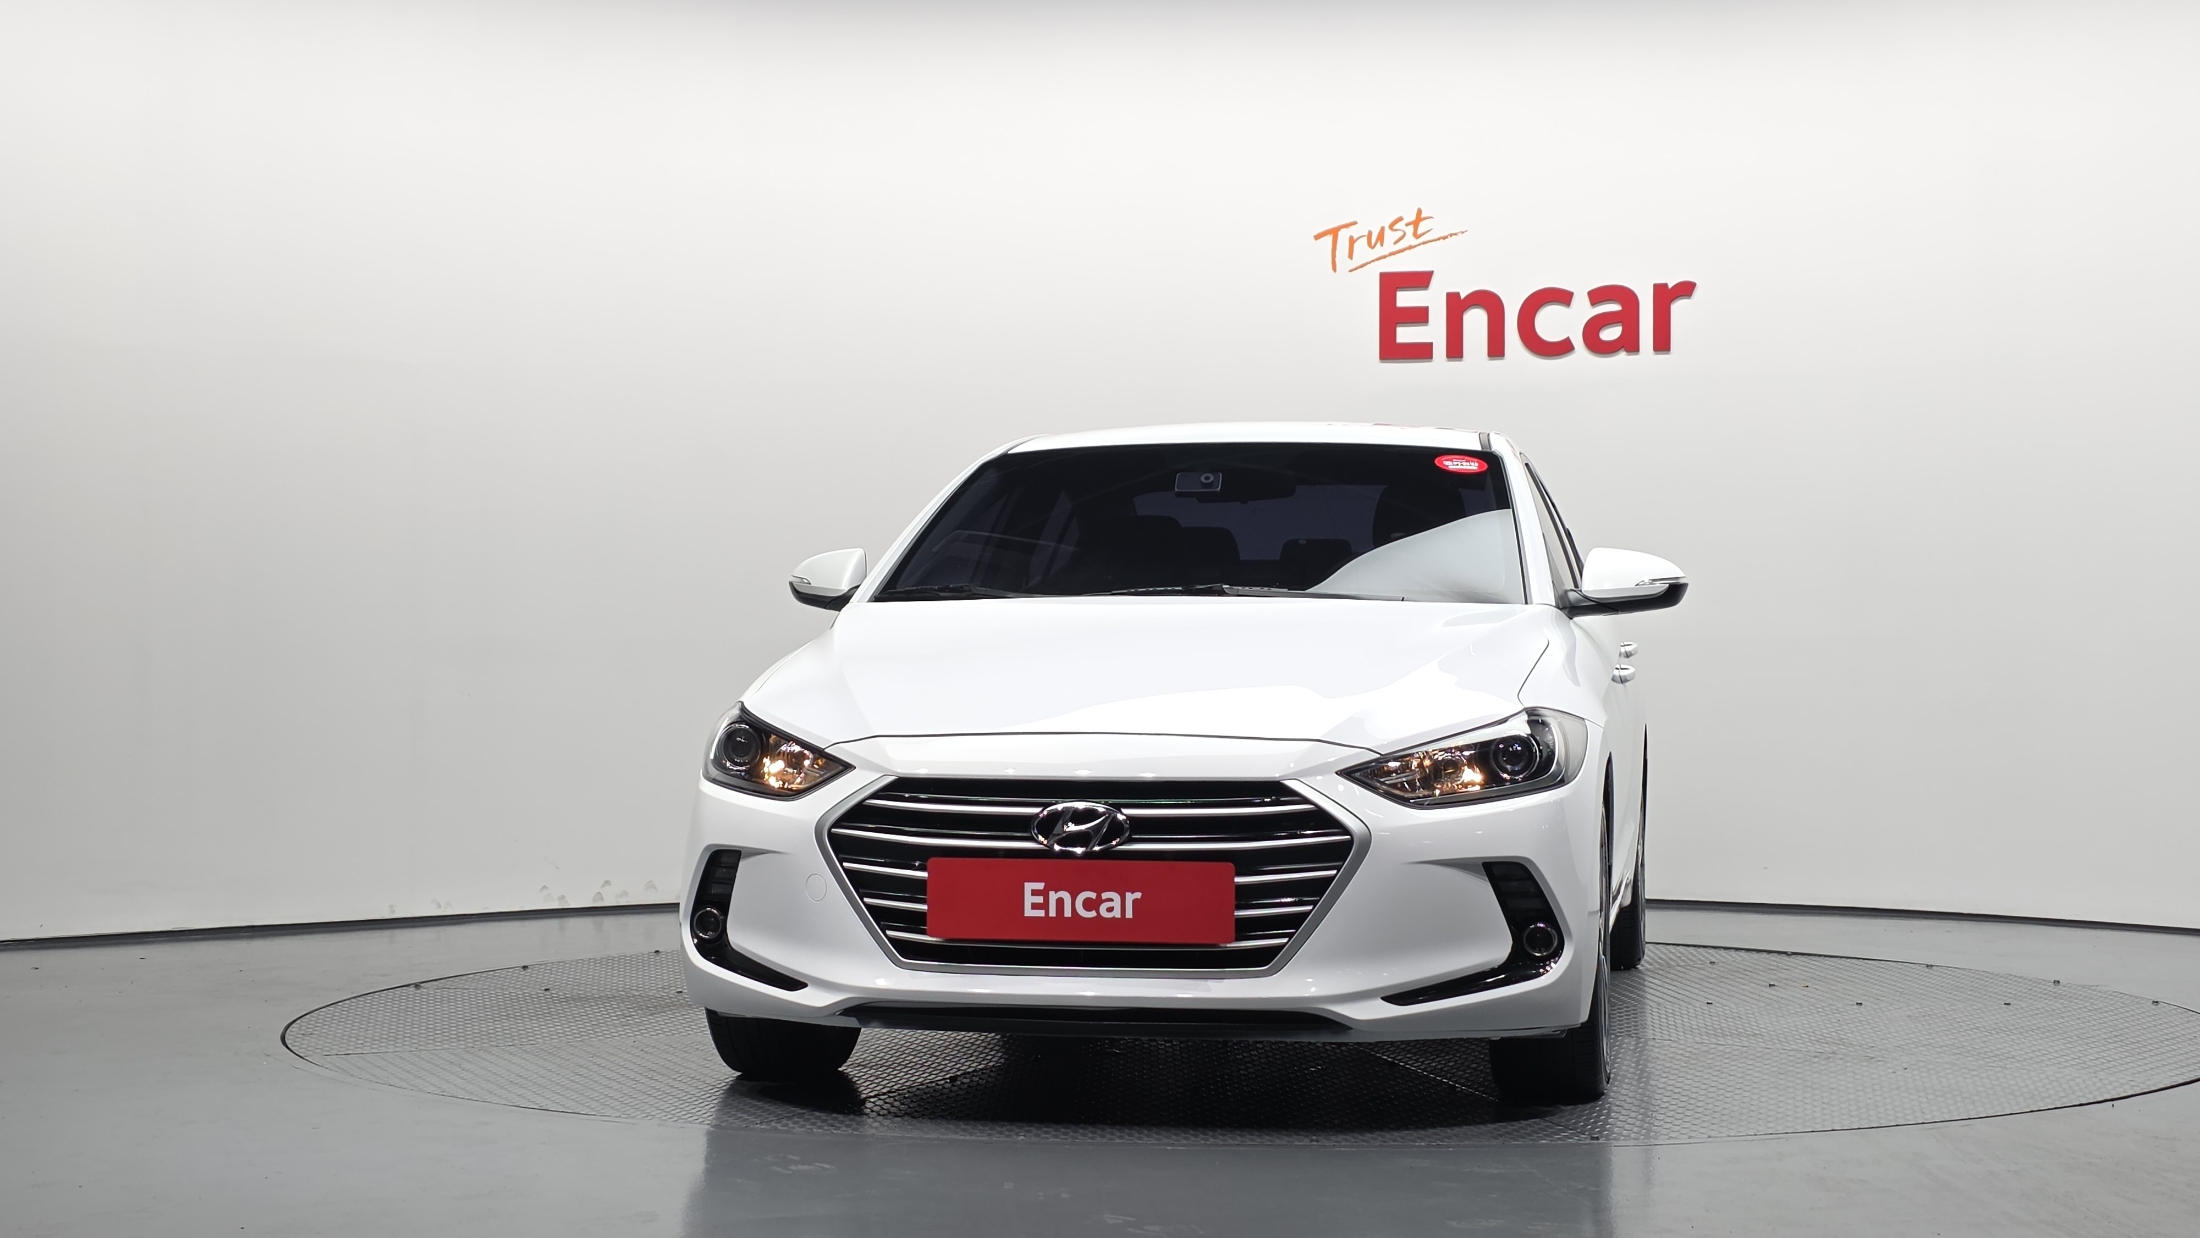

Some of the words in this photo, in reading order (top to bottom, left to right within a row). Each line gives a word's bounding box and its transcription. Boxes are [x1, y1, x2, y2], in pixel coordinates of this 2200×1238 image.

[1313, 207, 1434, 272] Trust
[1379, 270, 1697, 361] Encar
[1023, 882, 1142, 919] Encar
